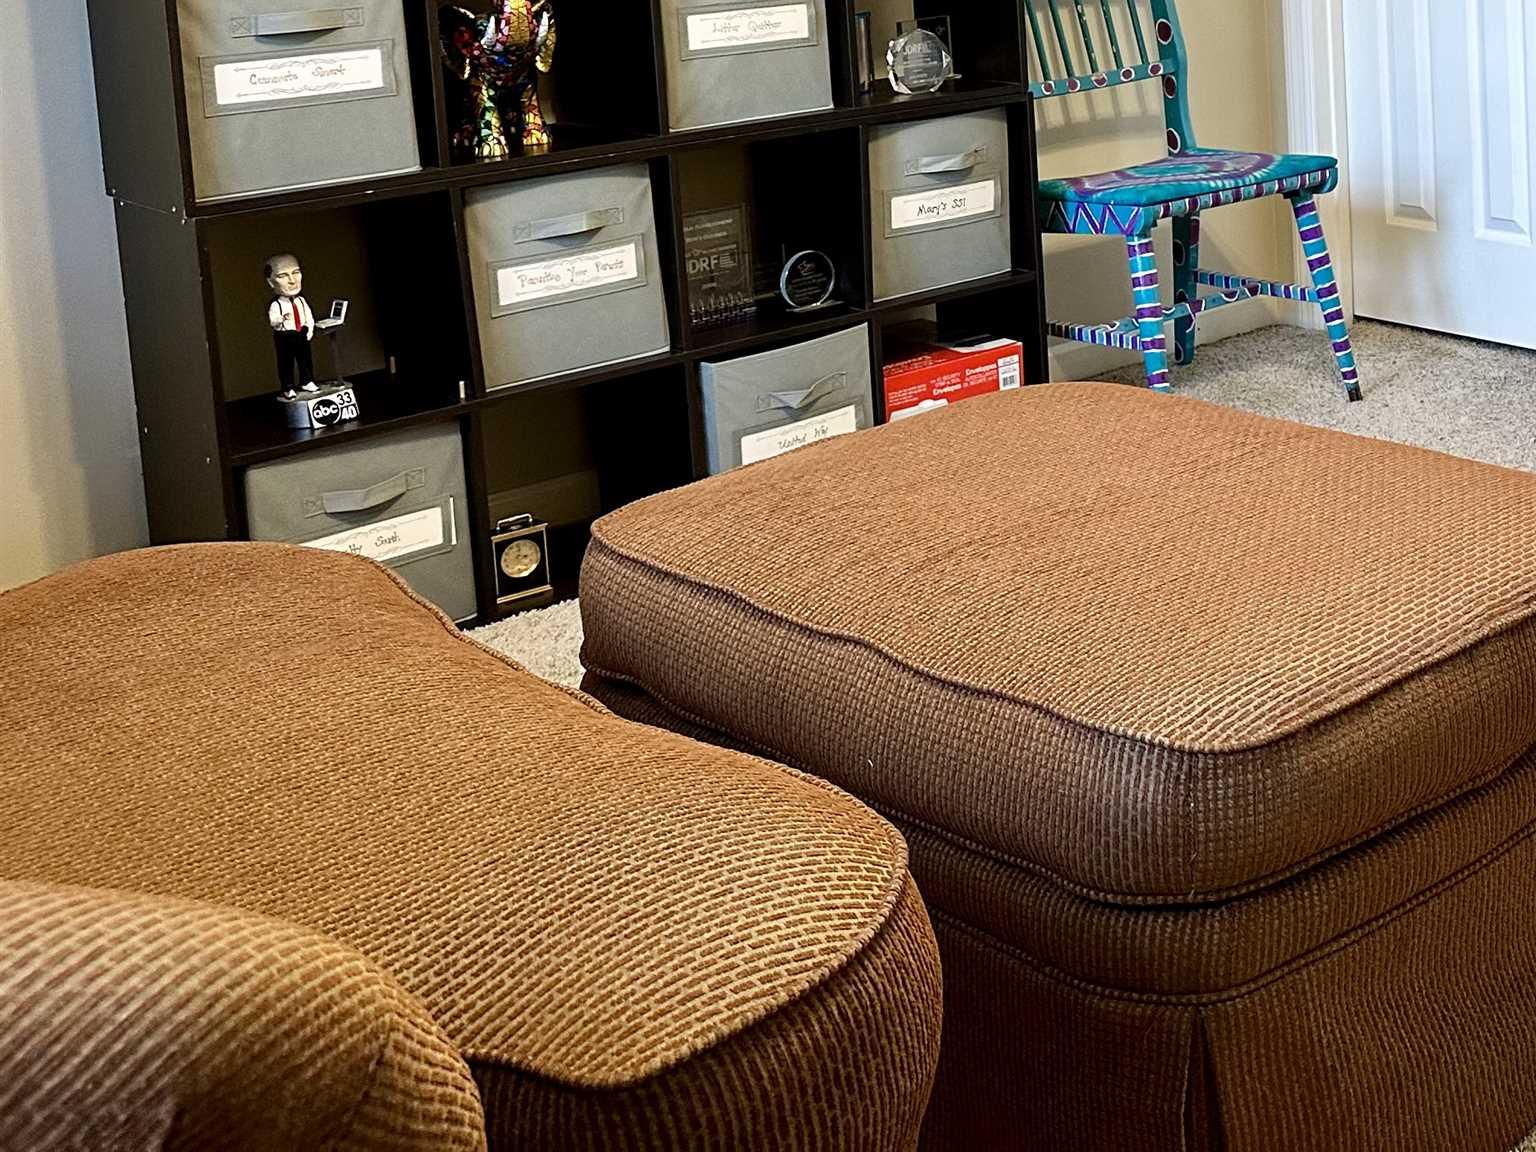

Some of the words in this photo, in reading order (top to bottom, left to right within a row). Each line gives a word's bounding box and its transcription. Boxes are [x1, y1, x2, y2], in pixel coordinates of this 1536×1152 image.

[313, 404, 338, 419] abc
[336, 391, 352, 406] 33
[341, 405, 358, 420] 40
